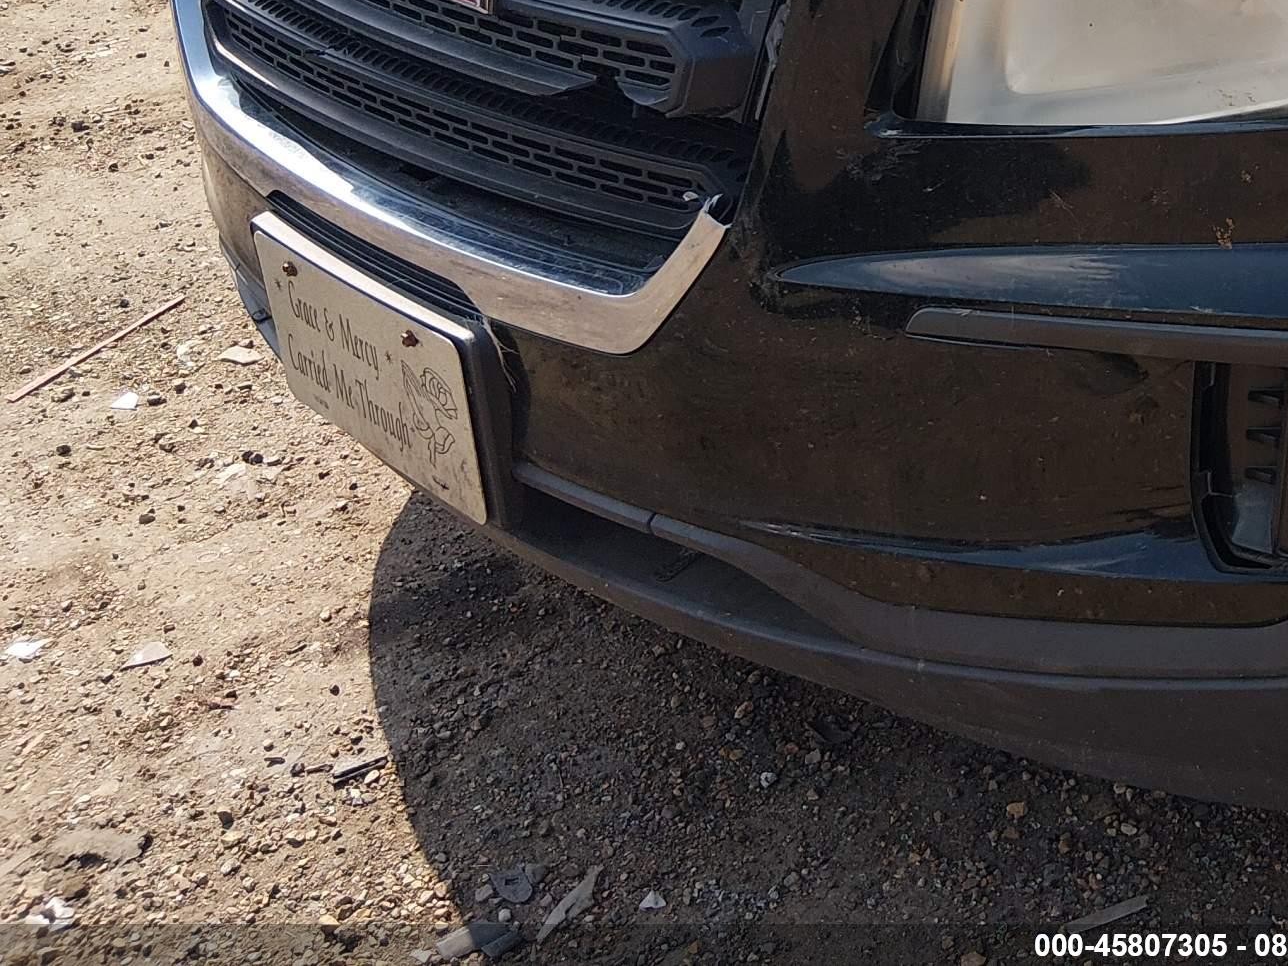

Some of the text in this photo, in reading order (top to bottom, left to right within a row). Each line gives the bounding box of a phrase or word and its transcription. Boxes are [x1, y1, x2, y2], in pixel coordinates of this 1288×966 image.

[288, 280, 379, 380] Grace & Mercy
[288, 333, 412, 452] Carried Me Through
